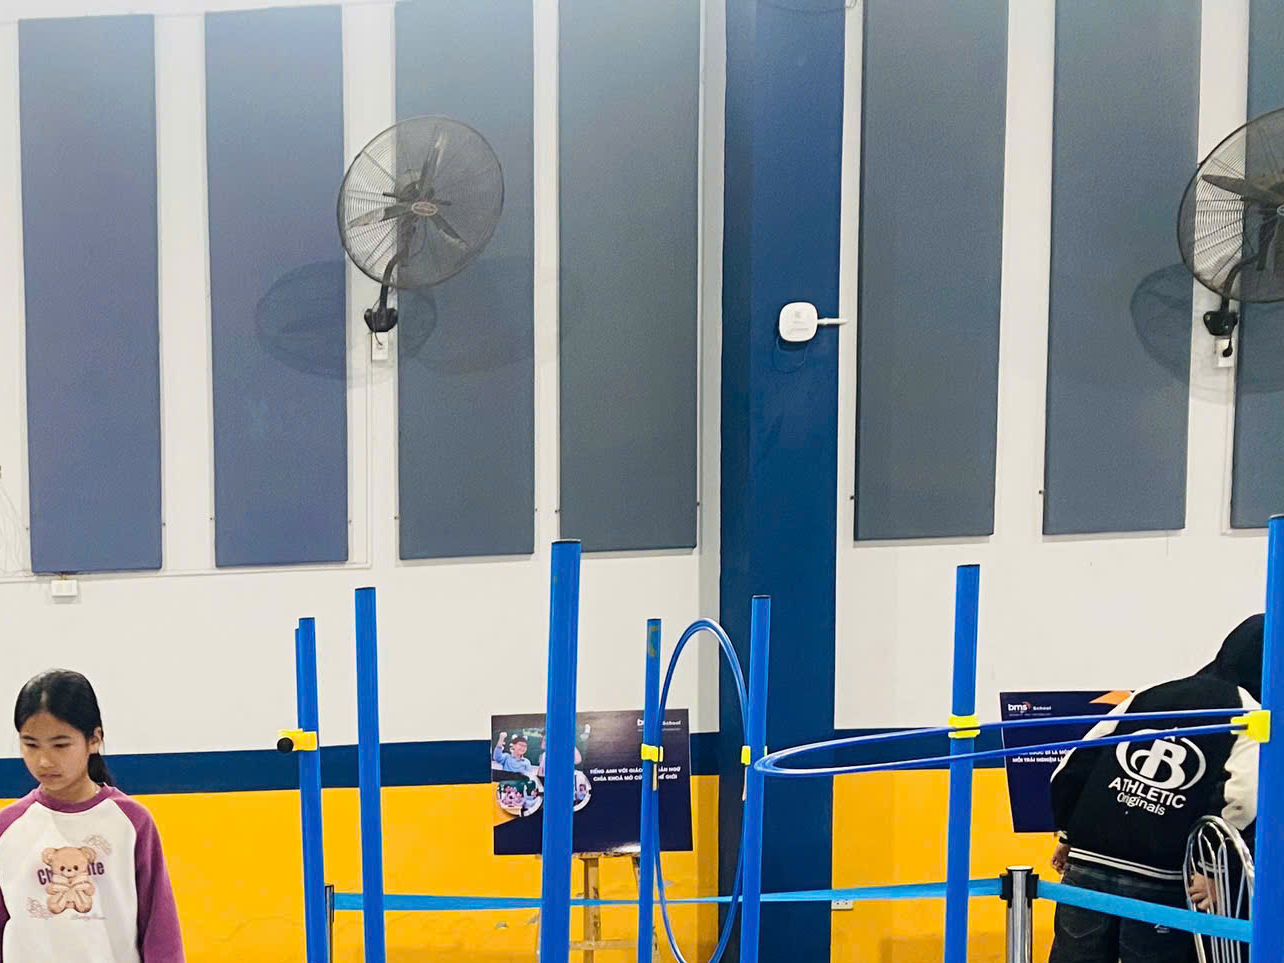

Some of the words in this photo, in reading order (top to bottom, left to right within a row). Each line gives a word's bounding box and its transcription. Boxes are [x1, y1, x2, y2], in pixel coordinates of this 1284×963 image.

[1008, 703, 1028, 712] bms
[1108, 776, 1187, 809] ATHLETIC
[1116, 791, 1166, 816] Originals
